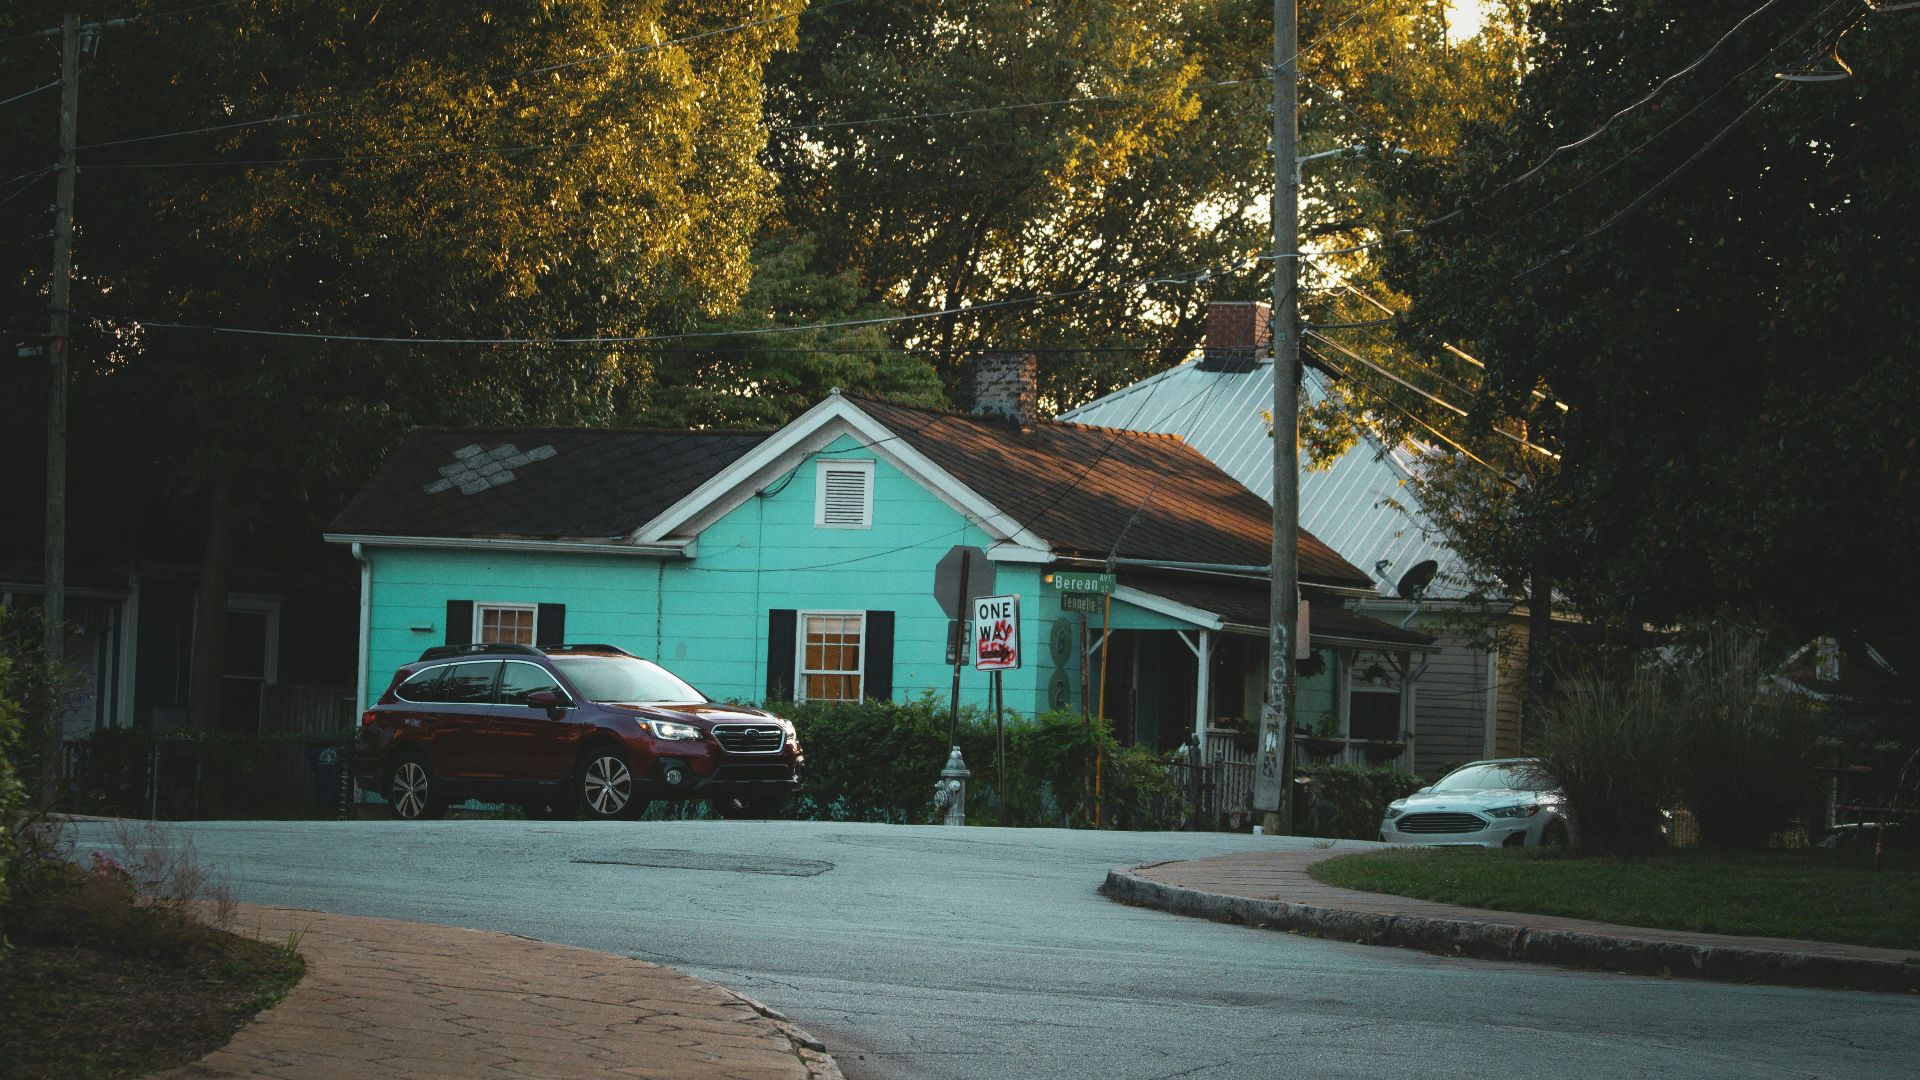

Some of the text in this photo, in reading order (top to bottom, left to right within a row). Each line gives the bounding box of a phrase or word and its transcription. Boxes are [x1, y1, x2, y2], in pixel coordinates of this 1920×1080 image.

[1055, 574, 1112, 591] Berean AVE
[979, 602, 1011, 620] ONE
[979, 623, 1012, 642] WAY
